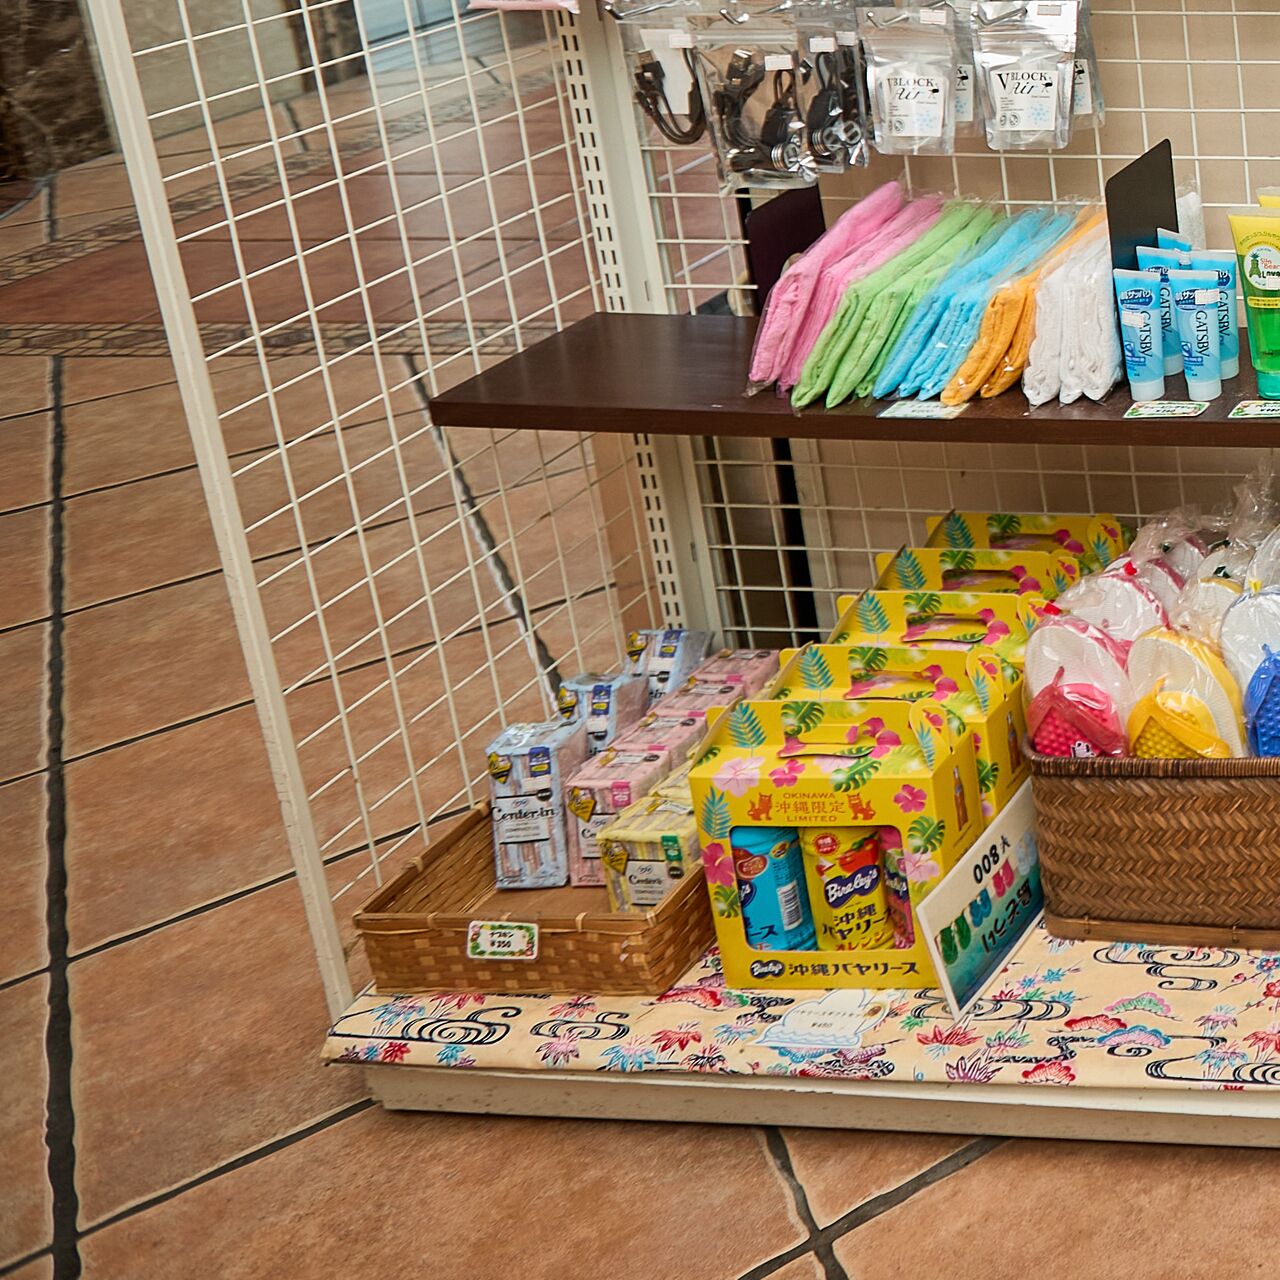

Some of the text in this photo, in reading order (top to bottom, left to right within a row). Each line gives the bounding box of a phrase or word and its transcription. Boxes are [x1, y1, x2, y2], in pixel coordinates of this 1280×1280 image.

[776, 802, 845, 813] 沖縄限定
[833, 906, 876, 925] 沖縄
[789, 963, 920, 976] 沖縄バヤリース
